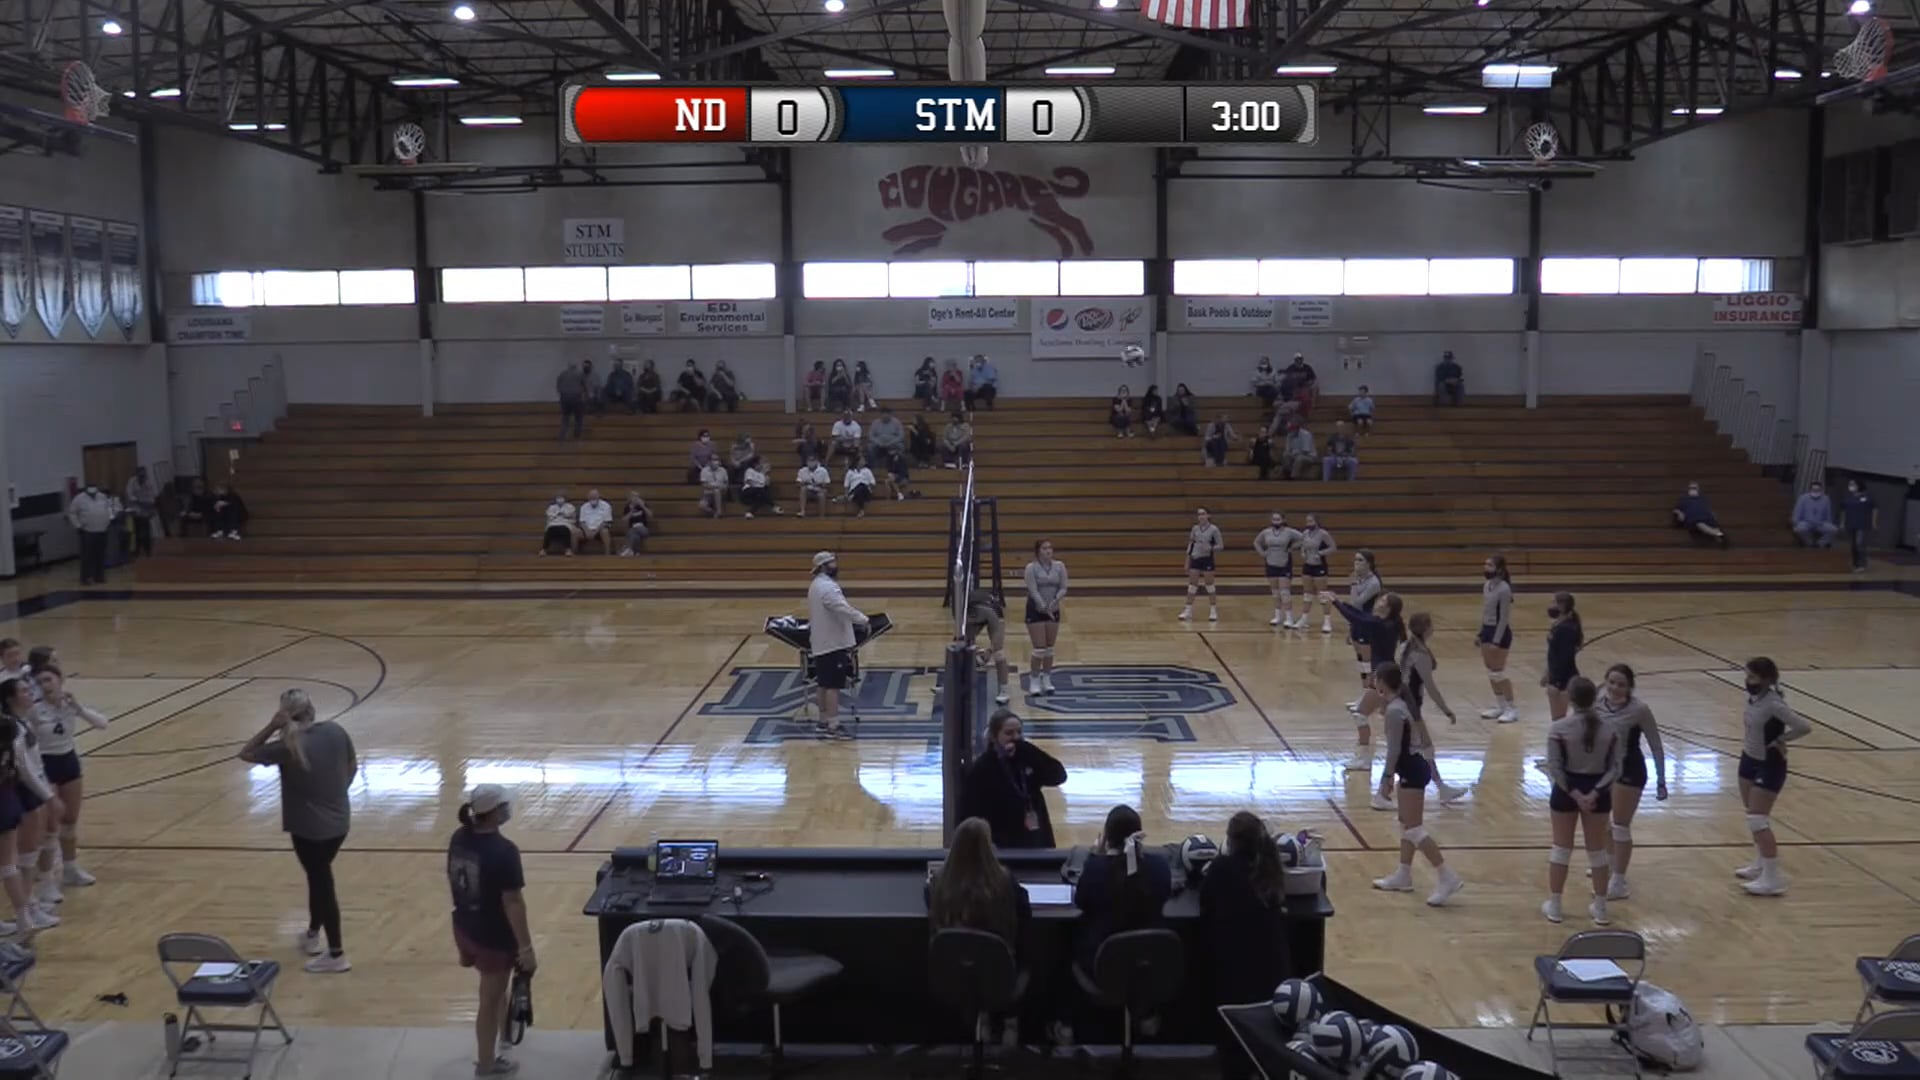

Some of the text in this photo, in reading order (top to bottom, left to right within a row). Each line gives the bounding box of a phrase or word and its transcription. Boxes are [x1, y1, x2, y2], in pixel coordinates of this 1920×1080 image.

[575, 224, 612, 239] STM
[565, 242, 625, 258] STUDENTS
[1727, 294, 1790, 307] LIGGIO
[707, 303, 738, 312] EDI
[988, 307, 1016, 319] Center
[1209, 307, 1231, 318] Pools
[1232, 307, 1239, 318] &
[1241, 307, 1273, 318] Outdoor
[680, 313, 766, 322] Environmental
[1714, 310, 1801, 322] INSURANCE
[697, 322, 749, 332] Services
[53, 722, 65, 735] 4
